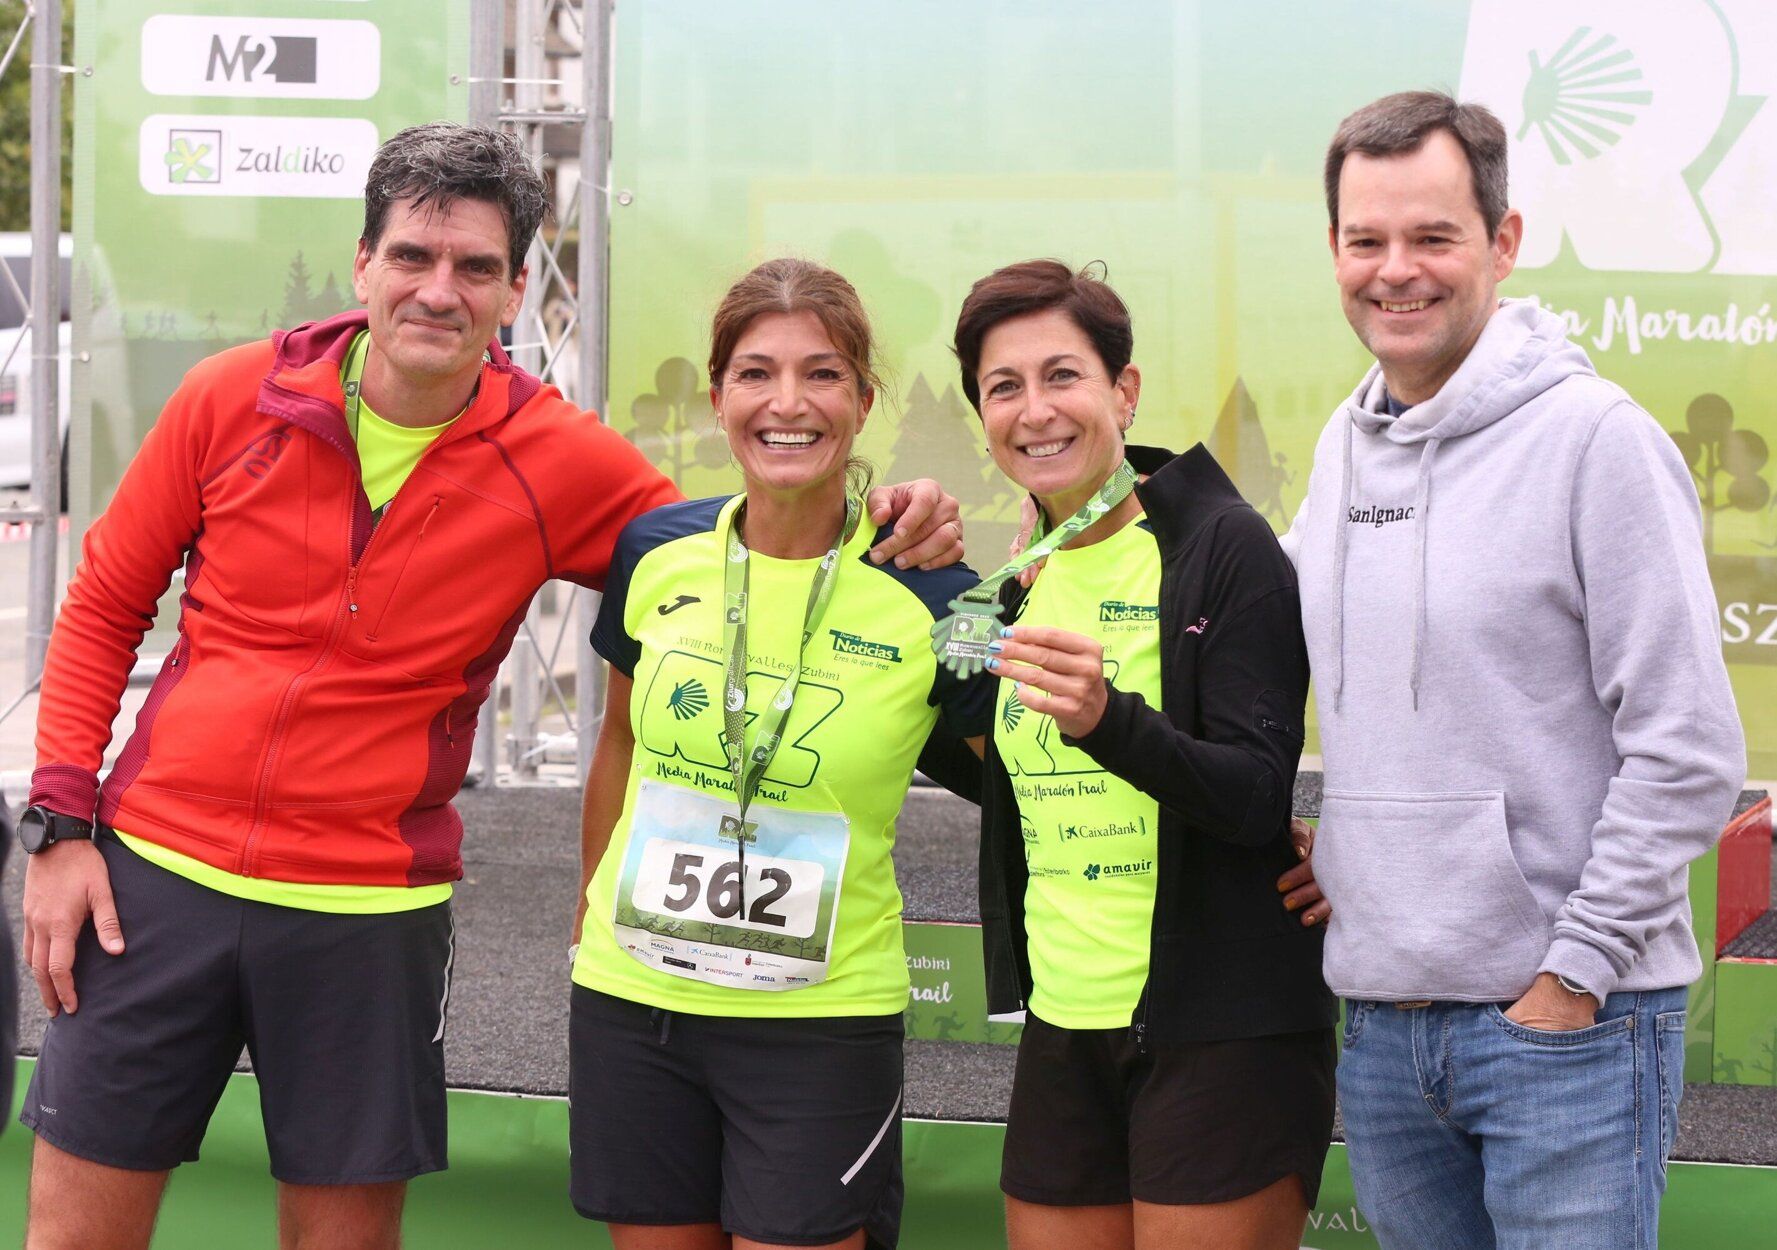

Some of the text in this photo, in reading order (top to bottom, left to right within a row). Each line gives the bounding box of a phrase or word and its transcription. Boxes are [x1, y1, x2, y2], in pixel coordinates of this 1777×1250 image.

[205, 34, 277, 83] M2
[1347, 505, 1428, 528] SanIgnac
[1101, 606, 1156, 620] Noticias
[835, 637, 894, 660] Noticias
[834, 653, 890, 671] Eres lo que lees
[656, 762, 691, 779] Media
[1077, 780, 1107, 797] Trail
[1079, 822, 1138, 839] CaixaBank
[1103, 859, 1152, 874] amavir
[663, 853, 792, 927] 562
[650, 942, 675, 953] MAGNA
[709, 968, 743, 978] INTERSPORT
[908, 981, 953, 1004] rail
